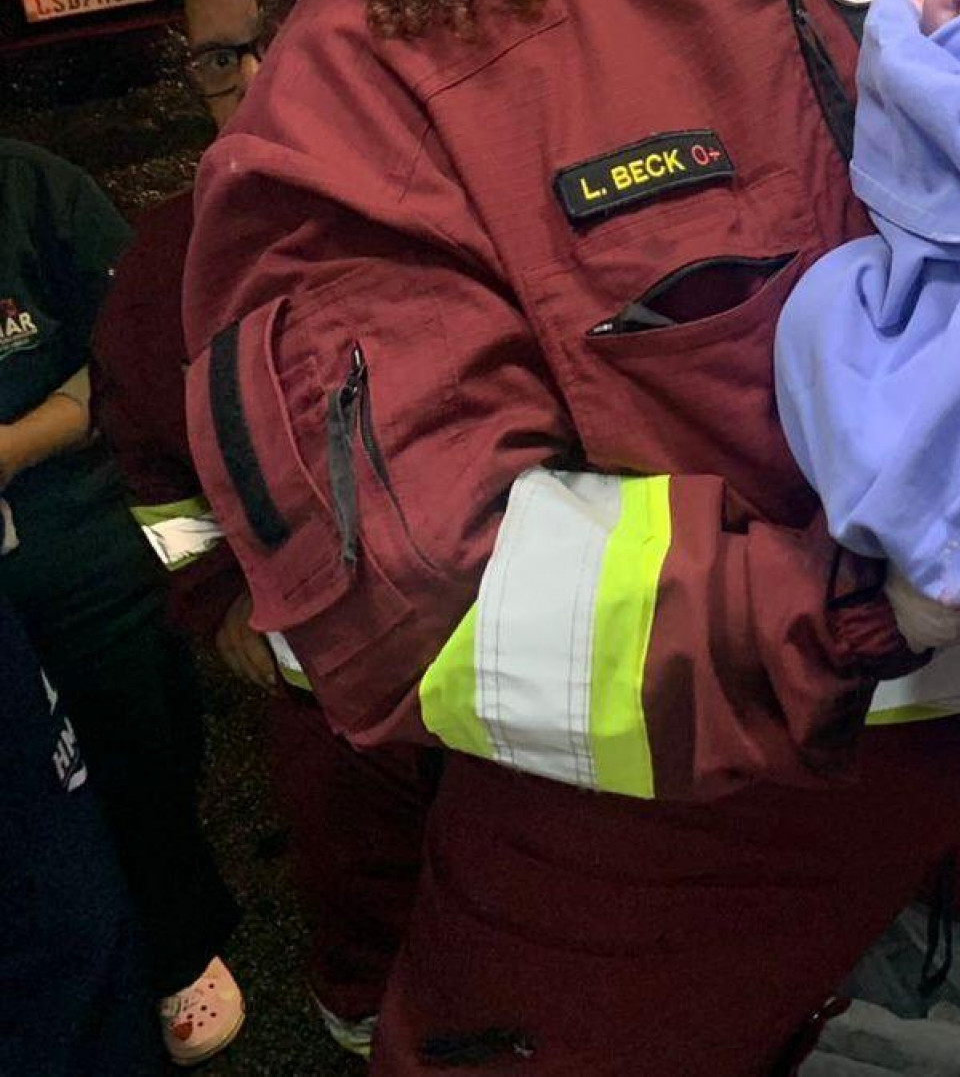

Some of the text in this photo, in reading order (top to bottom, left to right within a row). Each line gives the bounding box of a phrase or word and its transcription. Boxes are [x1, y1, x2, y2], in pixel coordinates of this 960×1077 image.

[580, 178, 608, 201] L.
[611, 149, 686, 190] BECK
[0, 312, 38, 337] AR
